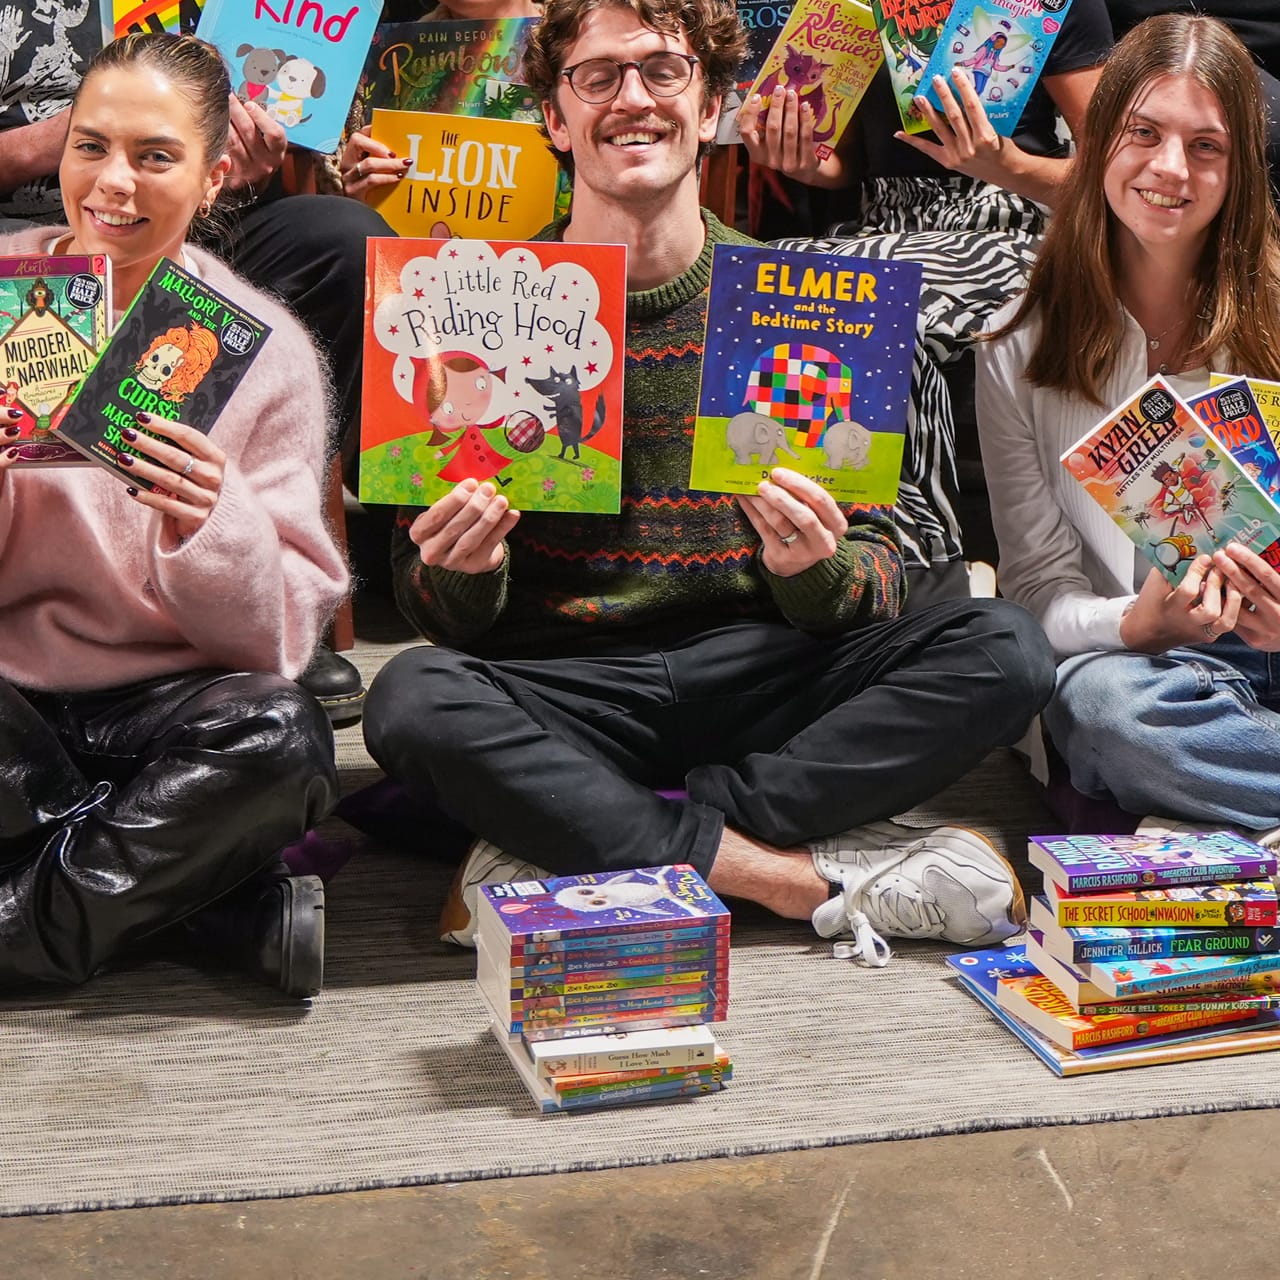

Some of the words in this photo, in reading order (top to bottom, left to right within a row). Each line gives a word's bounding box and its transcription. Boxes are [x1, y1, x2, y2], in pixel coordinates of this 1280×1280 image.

[420, 33, 448, 43] RAIN
[787, 13, 883, 61] Rescuers
[814, 4, 880, 44] Secret
[379, 42, 519, 96] Rainbow
[441, 130, 460, 146] THE
[406, 185, 513, 223] INSIDE
[157, 270, 221, 315] MALLORY
[444, 267, 502, 295] Little
[511, 270, 556, 301] Red
[756, 262, 878, 304] ELMER
[187, 310, 203, 322] AND
[203, 317, 217, 331] THE
[402, 298, 503, 351] Riding
[513, 302, 587, 350] Hood
[794, 303, 815, 313] and
[818, 304, 837, 314] the
[752, 312, 821, 331] Bedtime
[826, 318, 874, 339] Story
[4, 331, 72, 364] MURDER!
[6, 366, 16, 378] BY
[18, 349, 89, 388] NARWHAL!
[117, 377, 181, 423] CURSE
[1090, 409, 1142, 471] KYAN
[1115, 472, 1141, 497] BATTLES
[1139, 461, 1151, 472] THE
[1151, 426, 1184, 461] MULTIVERSE
[1072, 876, 1100, 889] MARCUS
[1101, 874, 1137, 887] RASHFORD
[1064, 907, 1079, 921] THE
[1083, 906, 1114, 922] SECRET
[1117, 905, 1151, 922] SCHOOL
[1155, 906, 1194, 922] INVASION
[1081, 945, 1123, 958] JENNIFER
[1128, 942, 1162, 955] KILLICK
[1170, 937, 1201, 953] FEAR
[1205, 935, 1249, 951] GROUND
[1158, 1003, 1184, 1012] JOKES
[1201, 1002, 1229, 1011] FUNNY
[651, 1049, 671, 1057] Much
